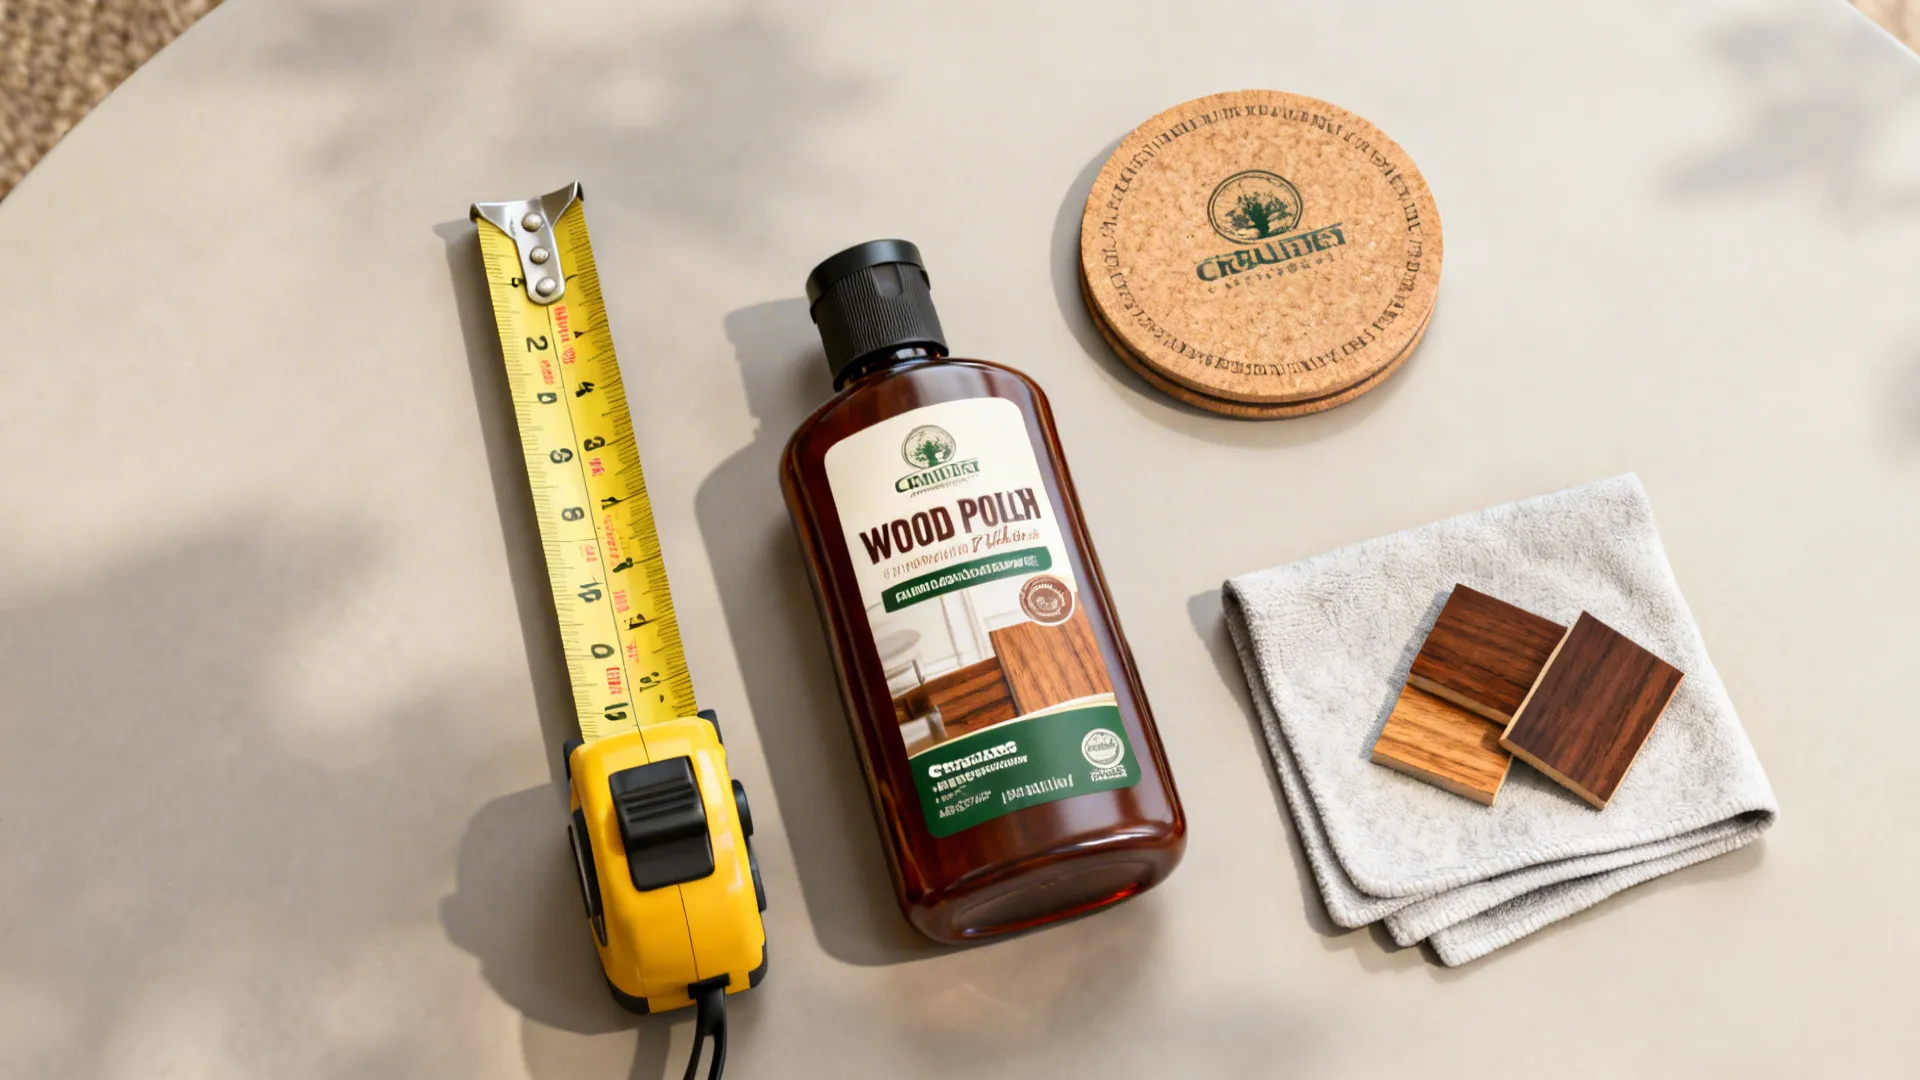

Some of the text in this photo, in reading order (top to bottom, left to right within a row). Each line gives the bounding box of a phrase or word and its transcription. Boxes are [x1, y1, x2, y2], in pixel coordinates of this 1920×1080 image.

[526, 335, 549, 353] 2
[561, 506, 585, 522] 8
[590, 643, 615, 659] 0
[859, 506, 956, 565] WOOD
